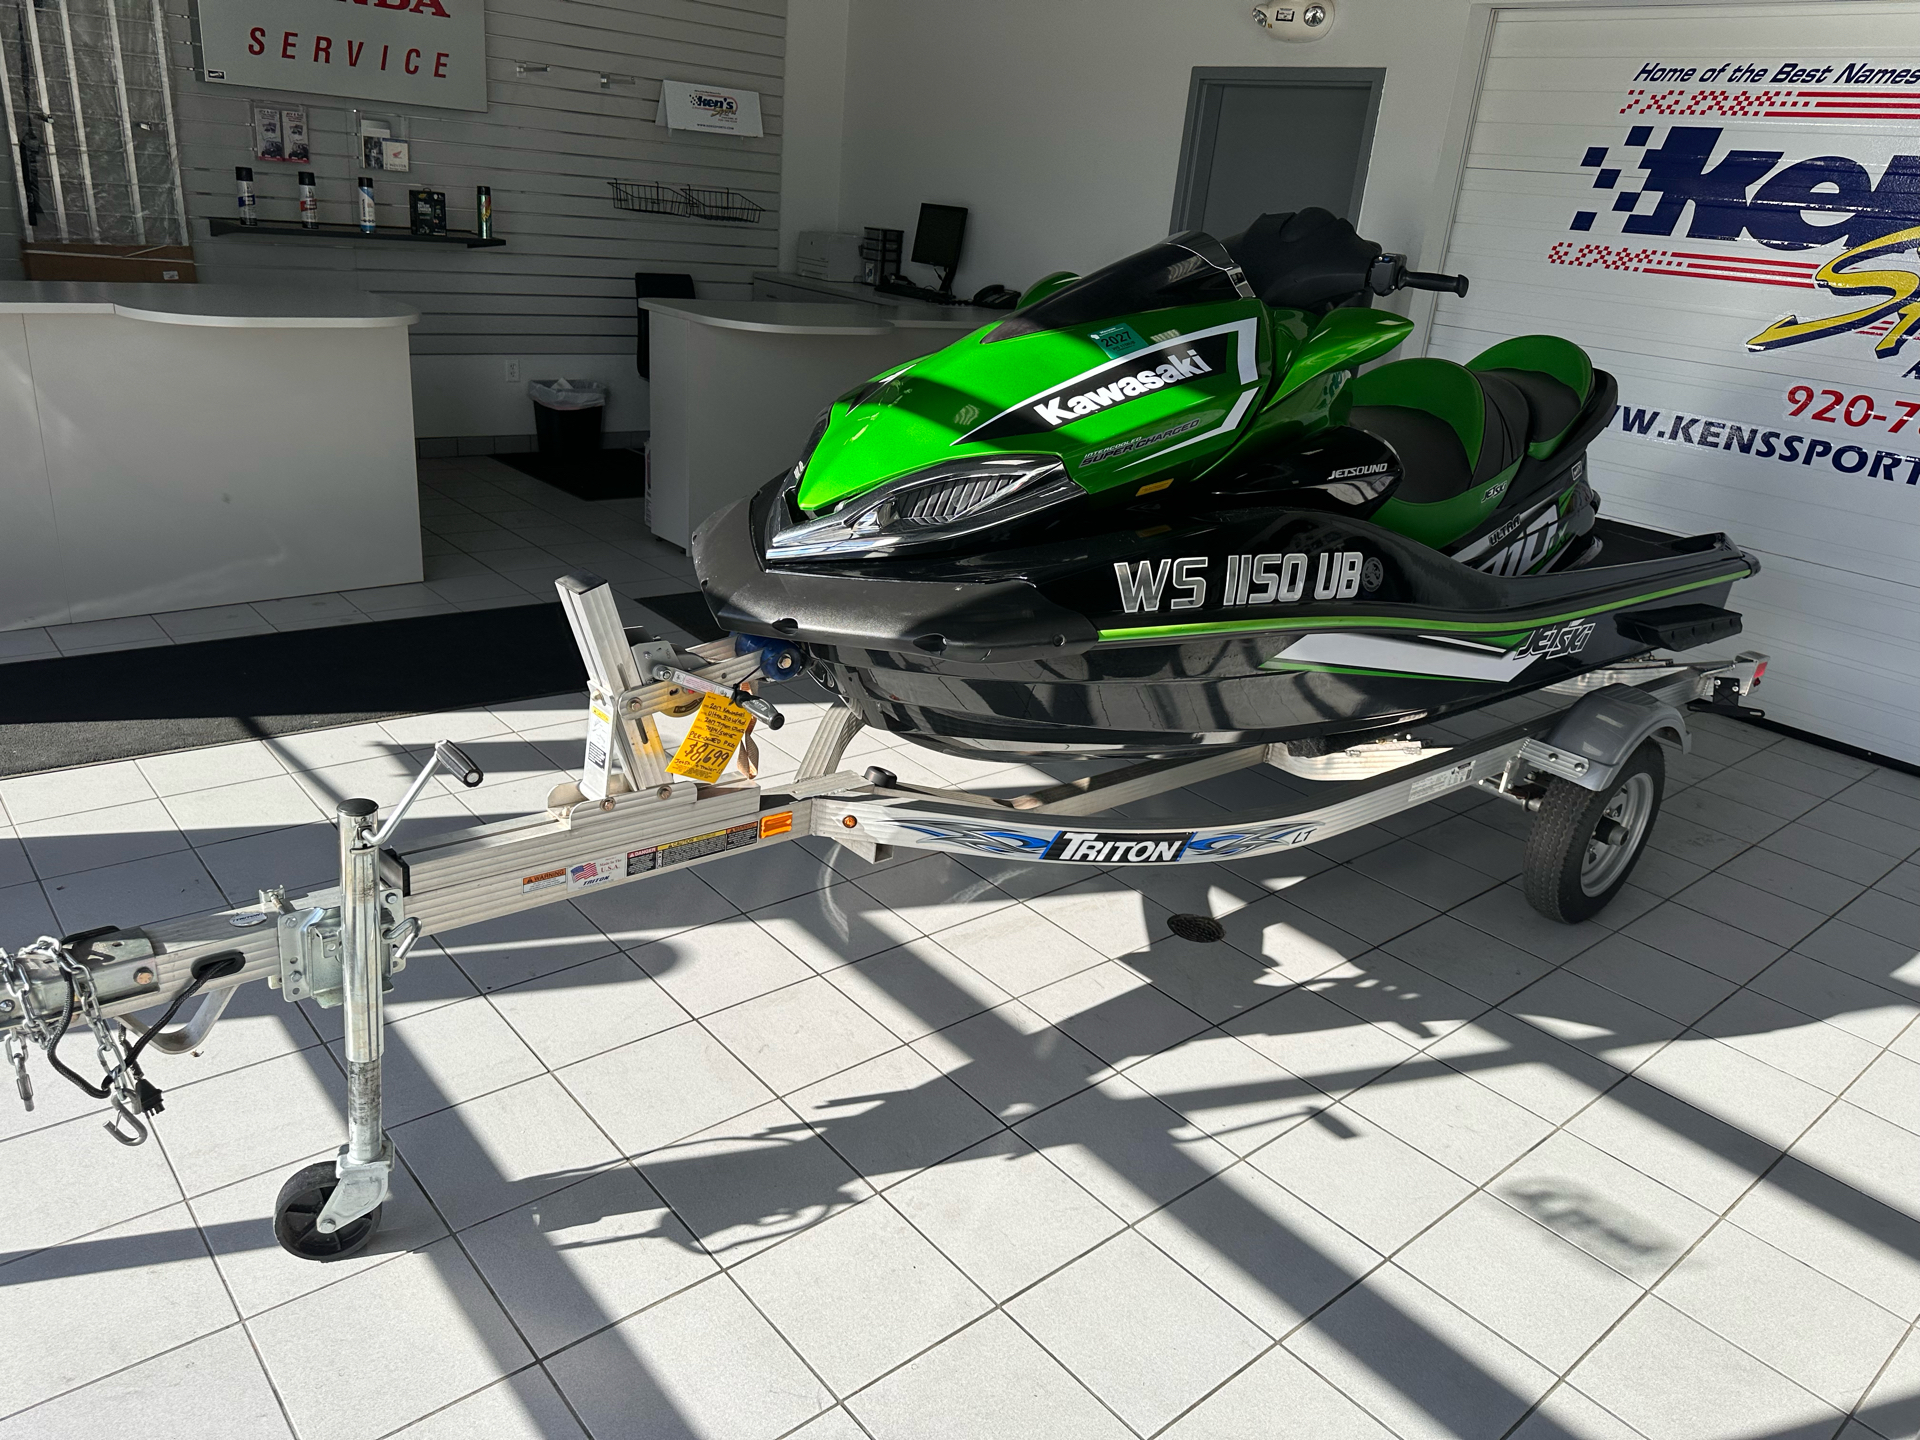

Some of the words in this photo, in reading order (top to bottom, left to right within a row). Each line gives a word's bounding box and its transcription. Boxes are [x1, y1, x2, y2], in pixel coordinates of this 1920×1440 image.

[248, 27, 449, 78] SERVICE
[1633, 63, 1697, 82] Home
[1699, 63, 1731, 82] of
[1728, 64, 1768, 83] the
[1770, 63, 1833, 84] Best
[1833, 63, 1920, 85] Names
[1101, 331, 1132, 348] 2027
[1033, 349, 1212, 426] Kawasaki
[1788, 385, 1920, 434] 920-7
[1080, 444, 1134, 468] SUPER
[1136, 418, 1200, 449] CHARGED
[1085, 437, 1142, 459] INTERCOOLED
[1327, 463, 1388, 480] JETSOUND
[1488, 513, 1521, 547] ULTRA
[1114, 556, 1208, 613] WS
[1223, 552, 1307, 606] 1150
[1314, 551, 1363, 600] UB
[684, 741, 730, 767] $8,699
[1288, 828, 1317, 845] LT
[635, 847, 656, 857] DANGER
[534, 869, 565, 882] WARNING
[583, 875, 610, 886] TRITON
